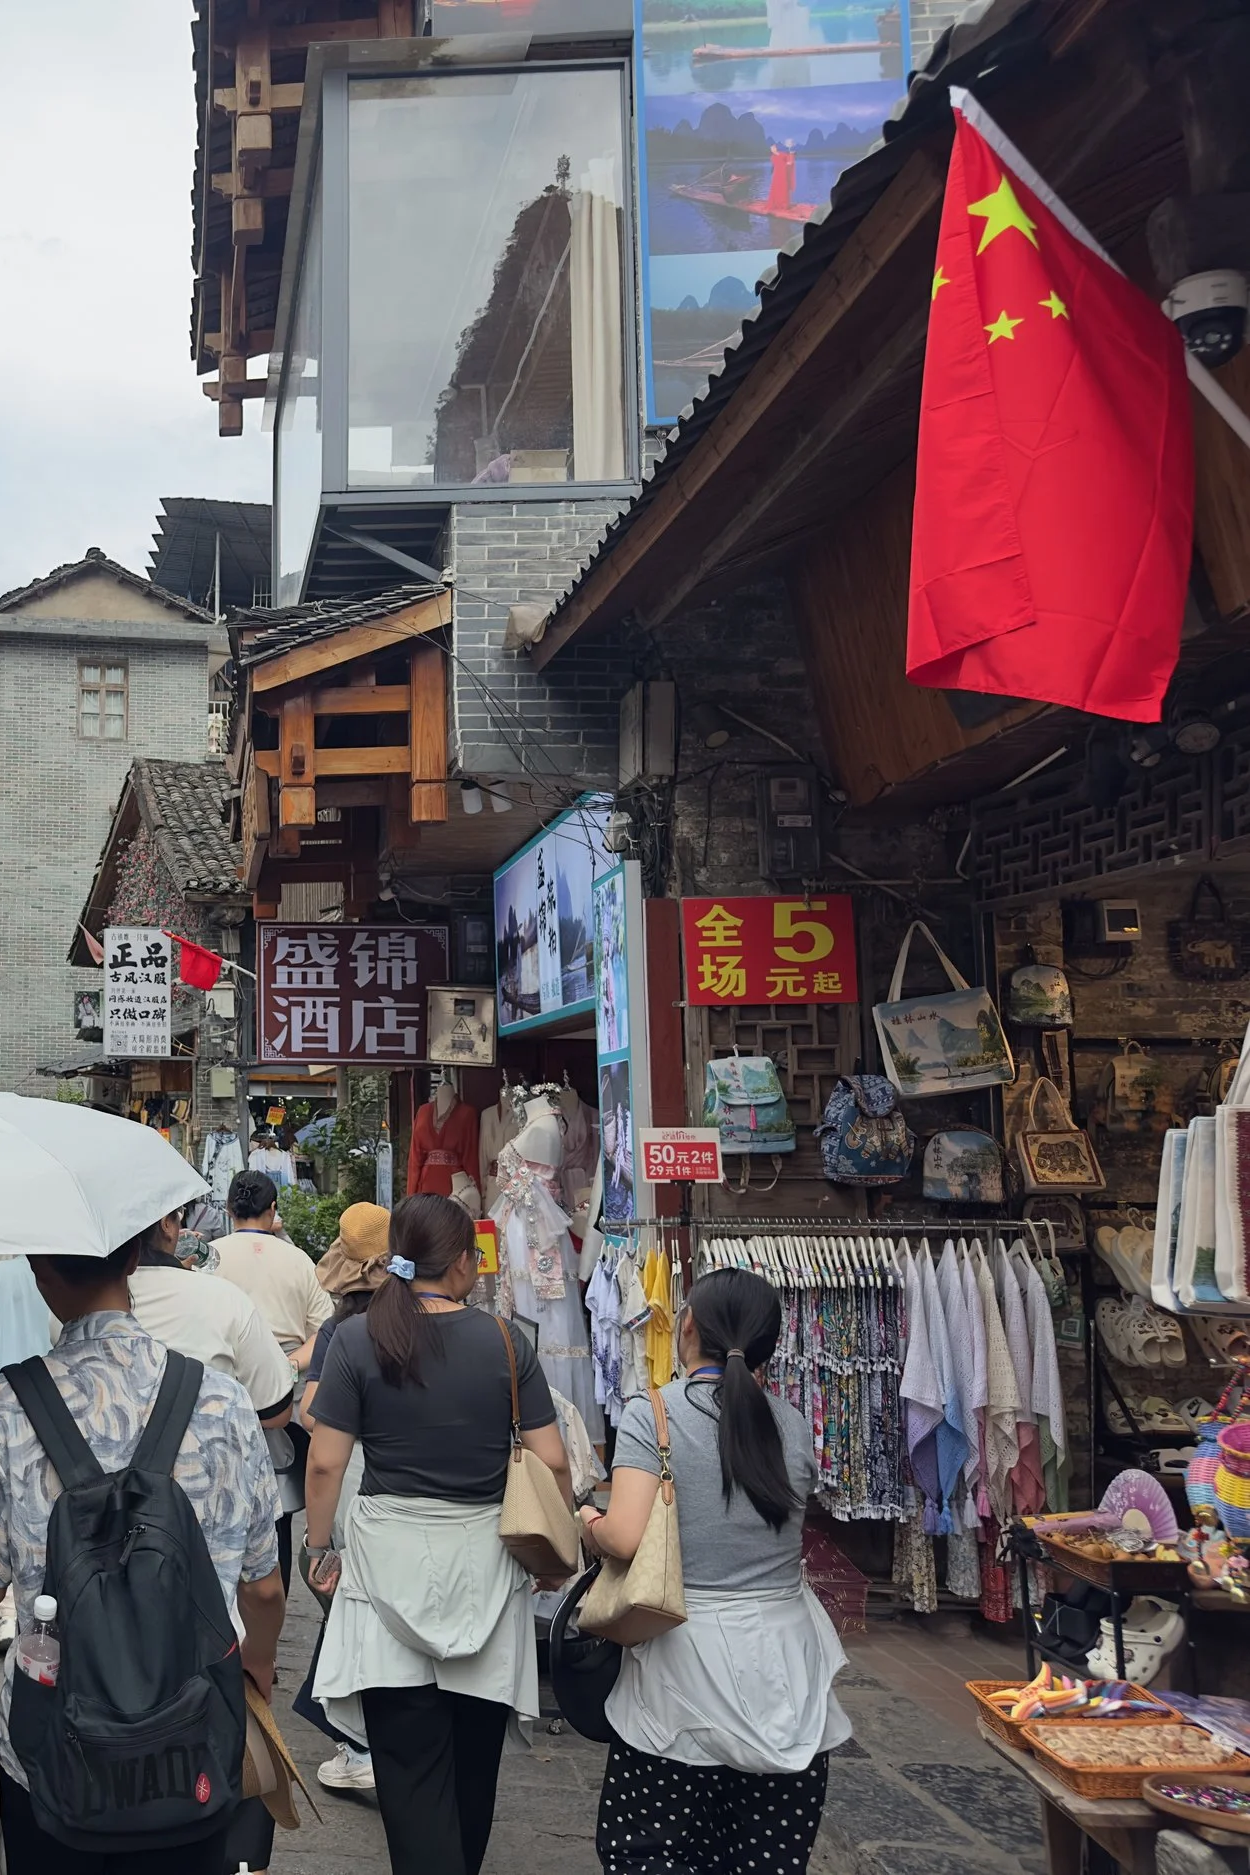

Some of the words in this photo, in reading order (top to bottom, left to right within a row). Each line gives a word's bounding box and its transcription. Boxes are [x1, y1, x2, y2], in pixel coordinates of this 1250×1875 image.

[774, 901, 835, 962] 5
[109, 942, 168, 969] 正品
[271, 932, 418, 990] 盛锦
[695, 904, 747, 998] 全场
[110, 971, 167, 985] 古风汉服
[766, 968, 842, 998] 元起
[110, 1007, 167, 1021] 只做口碑
[271, 996, 419, 1055] 酒店
[891, 1010, 940, 1025] 桂林山水
[650, 1145, 714, 1164] 50元2件
[649, 1165, 691, 1176] 29元1件
